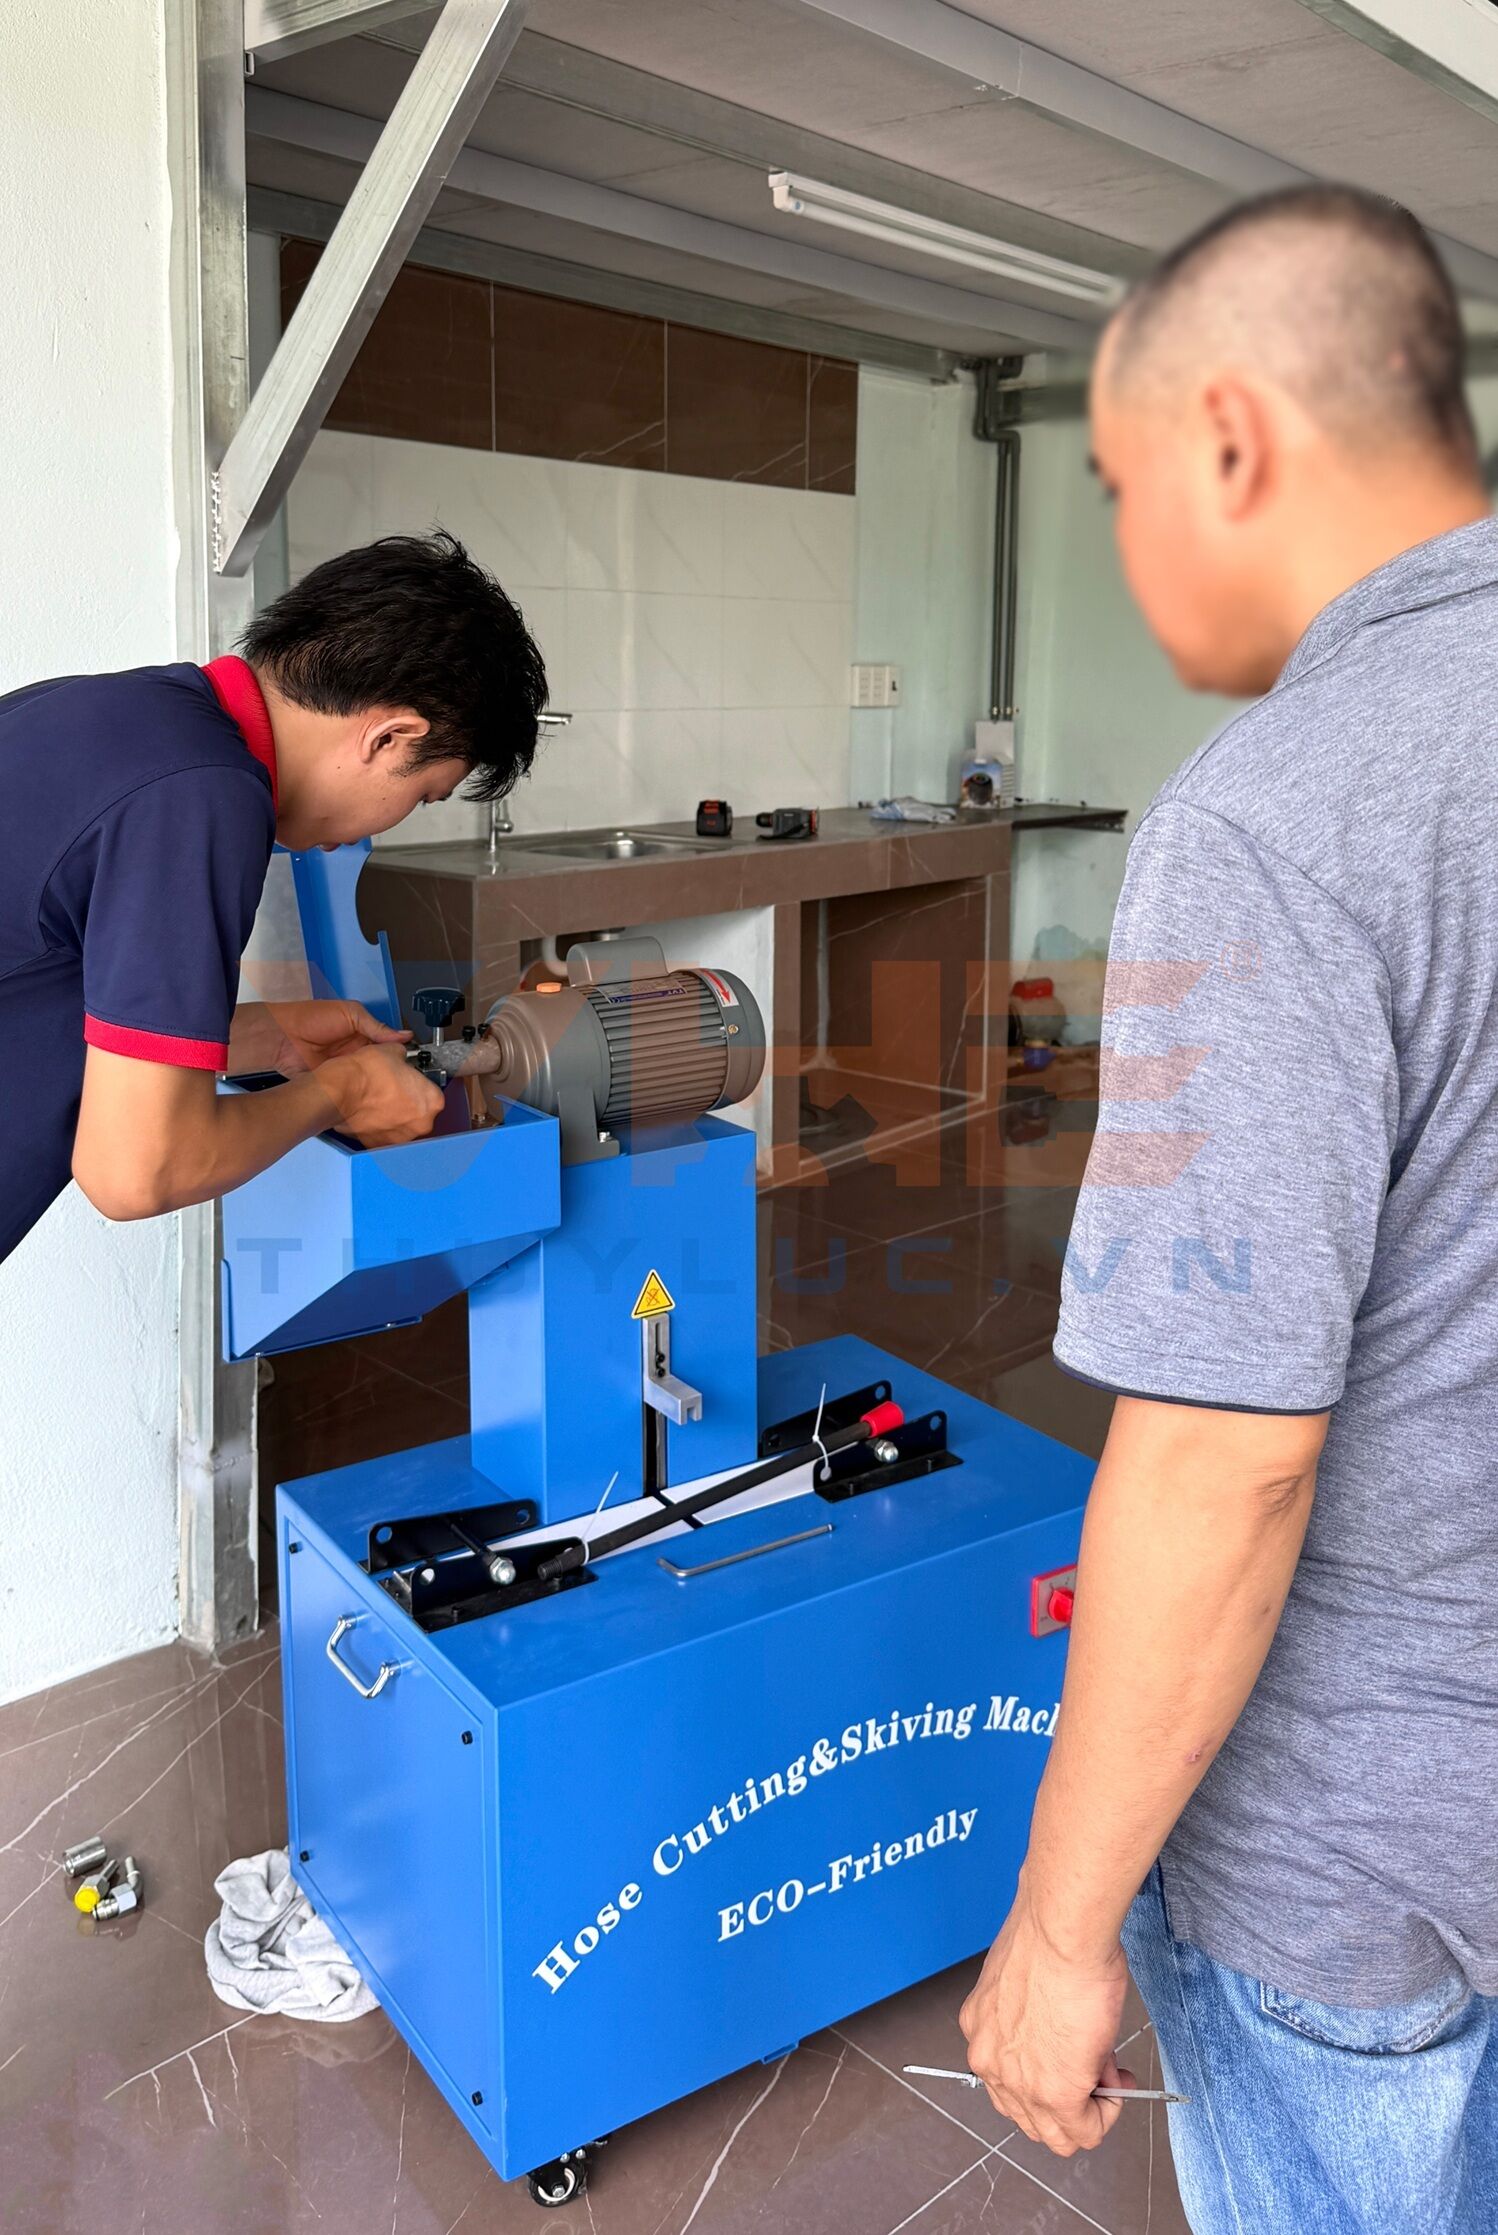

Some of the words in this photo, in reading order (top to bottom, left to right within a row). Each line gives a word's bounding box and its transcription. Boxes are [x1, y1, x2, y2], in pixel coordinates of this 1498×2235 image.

[531, 1881, 643, 1994] Hose
[652, 1702, 977, 1876] Cutting&Skiving
[717, 1807, 978, 1942] ECO-Friendly
